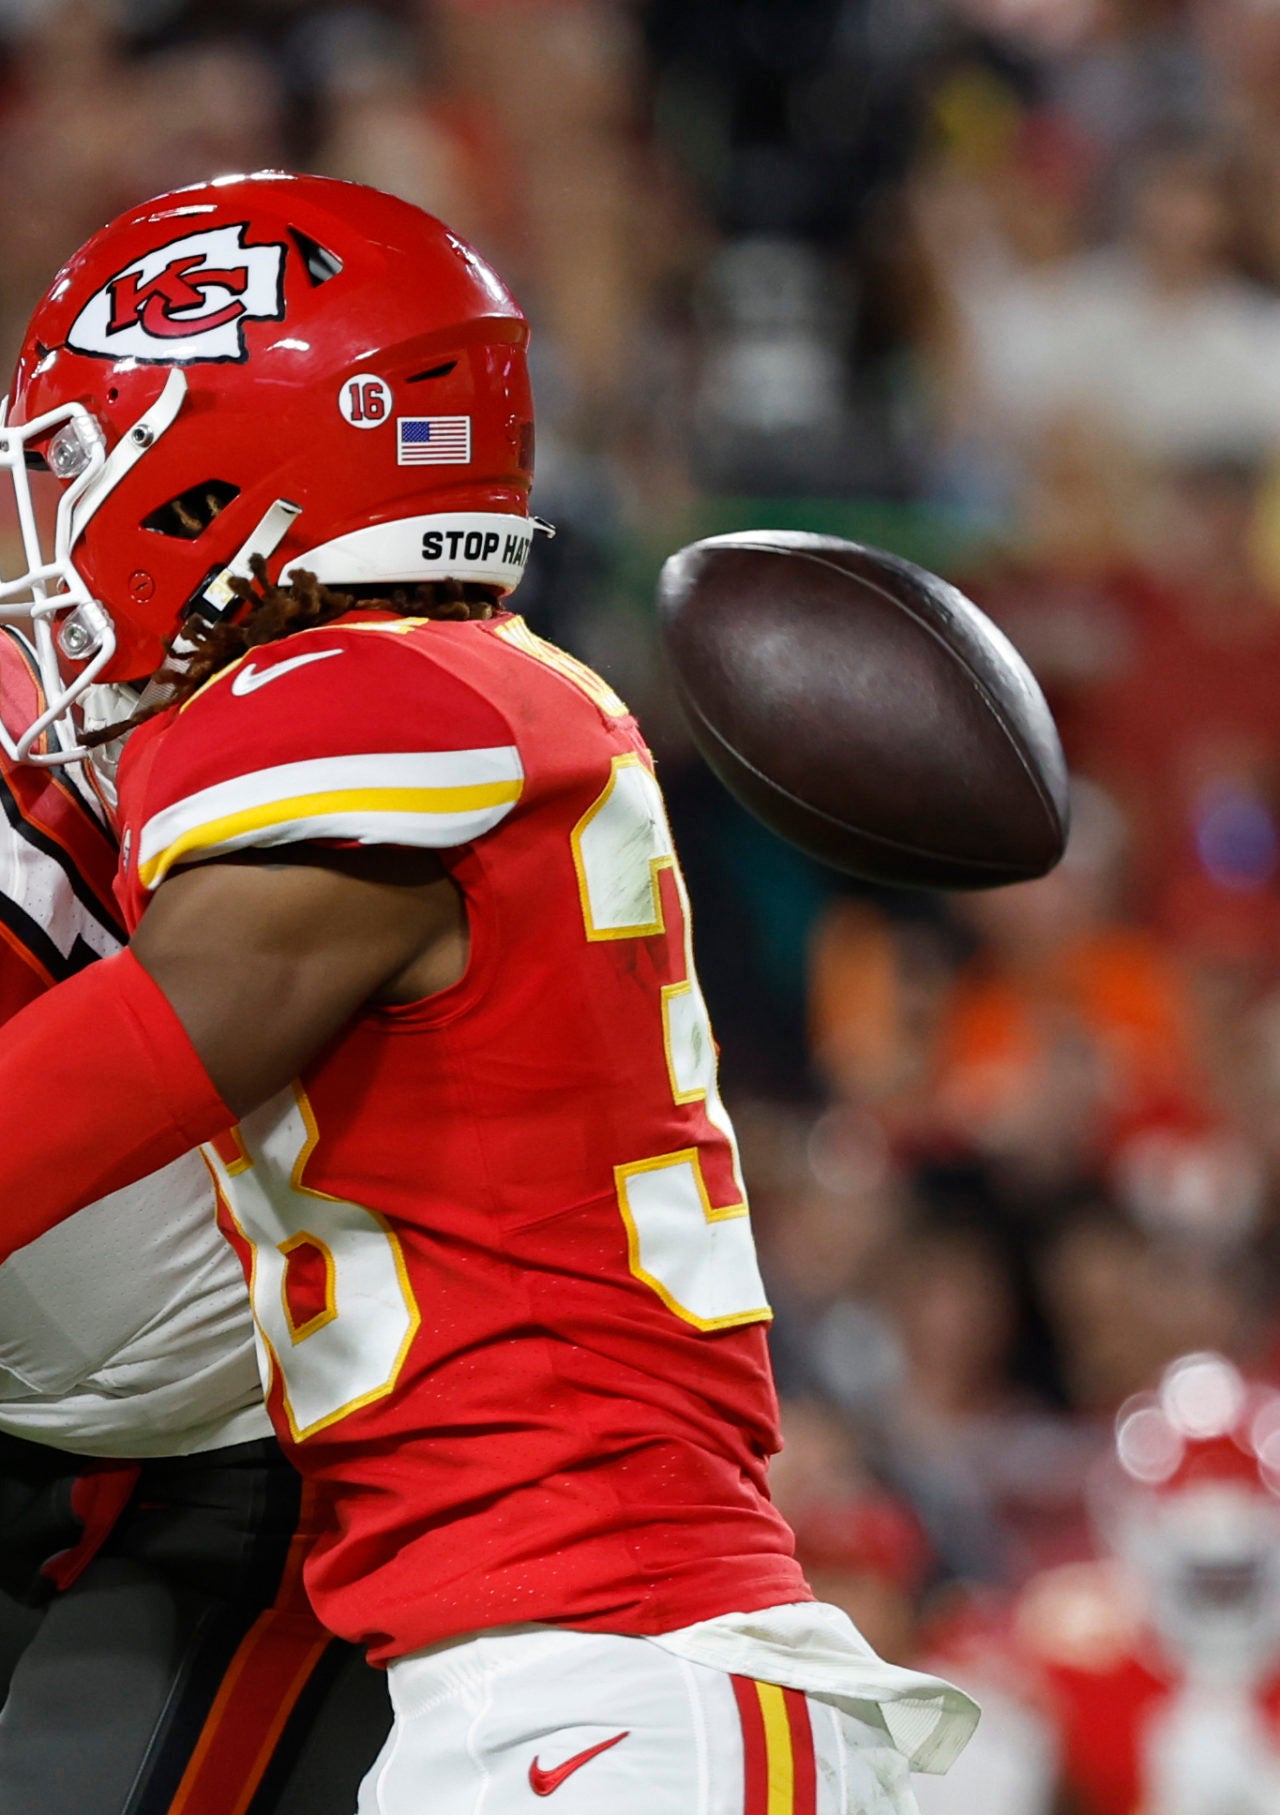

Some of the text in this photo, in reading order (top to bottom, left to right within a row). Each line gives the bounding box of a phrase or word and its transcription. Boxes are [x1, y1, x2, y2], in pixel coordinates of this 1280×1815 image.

[106, 253, 249, 339] KC
[348, 382, 385, 421] 16
[421, 531, 500, 561] STOP
